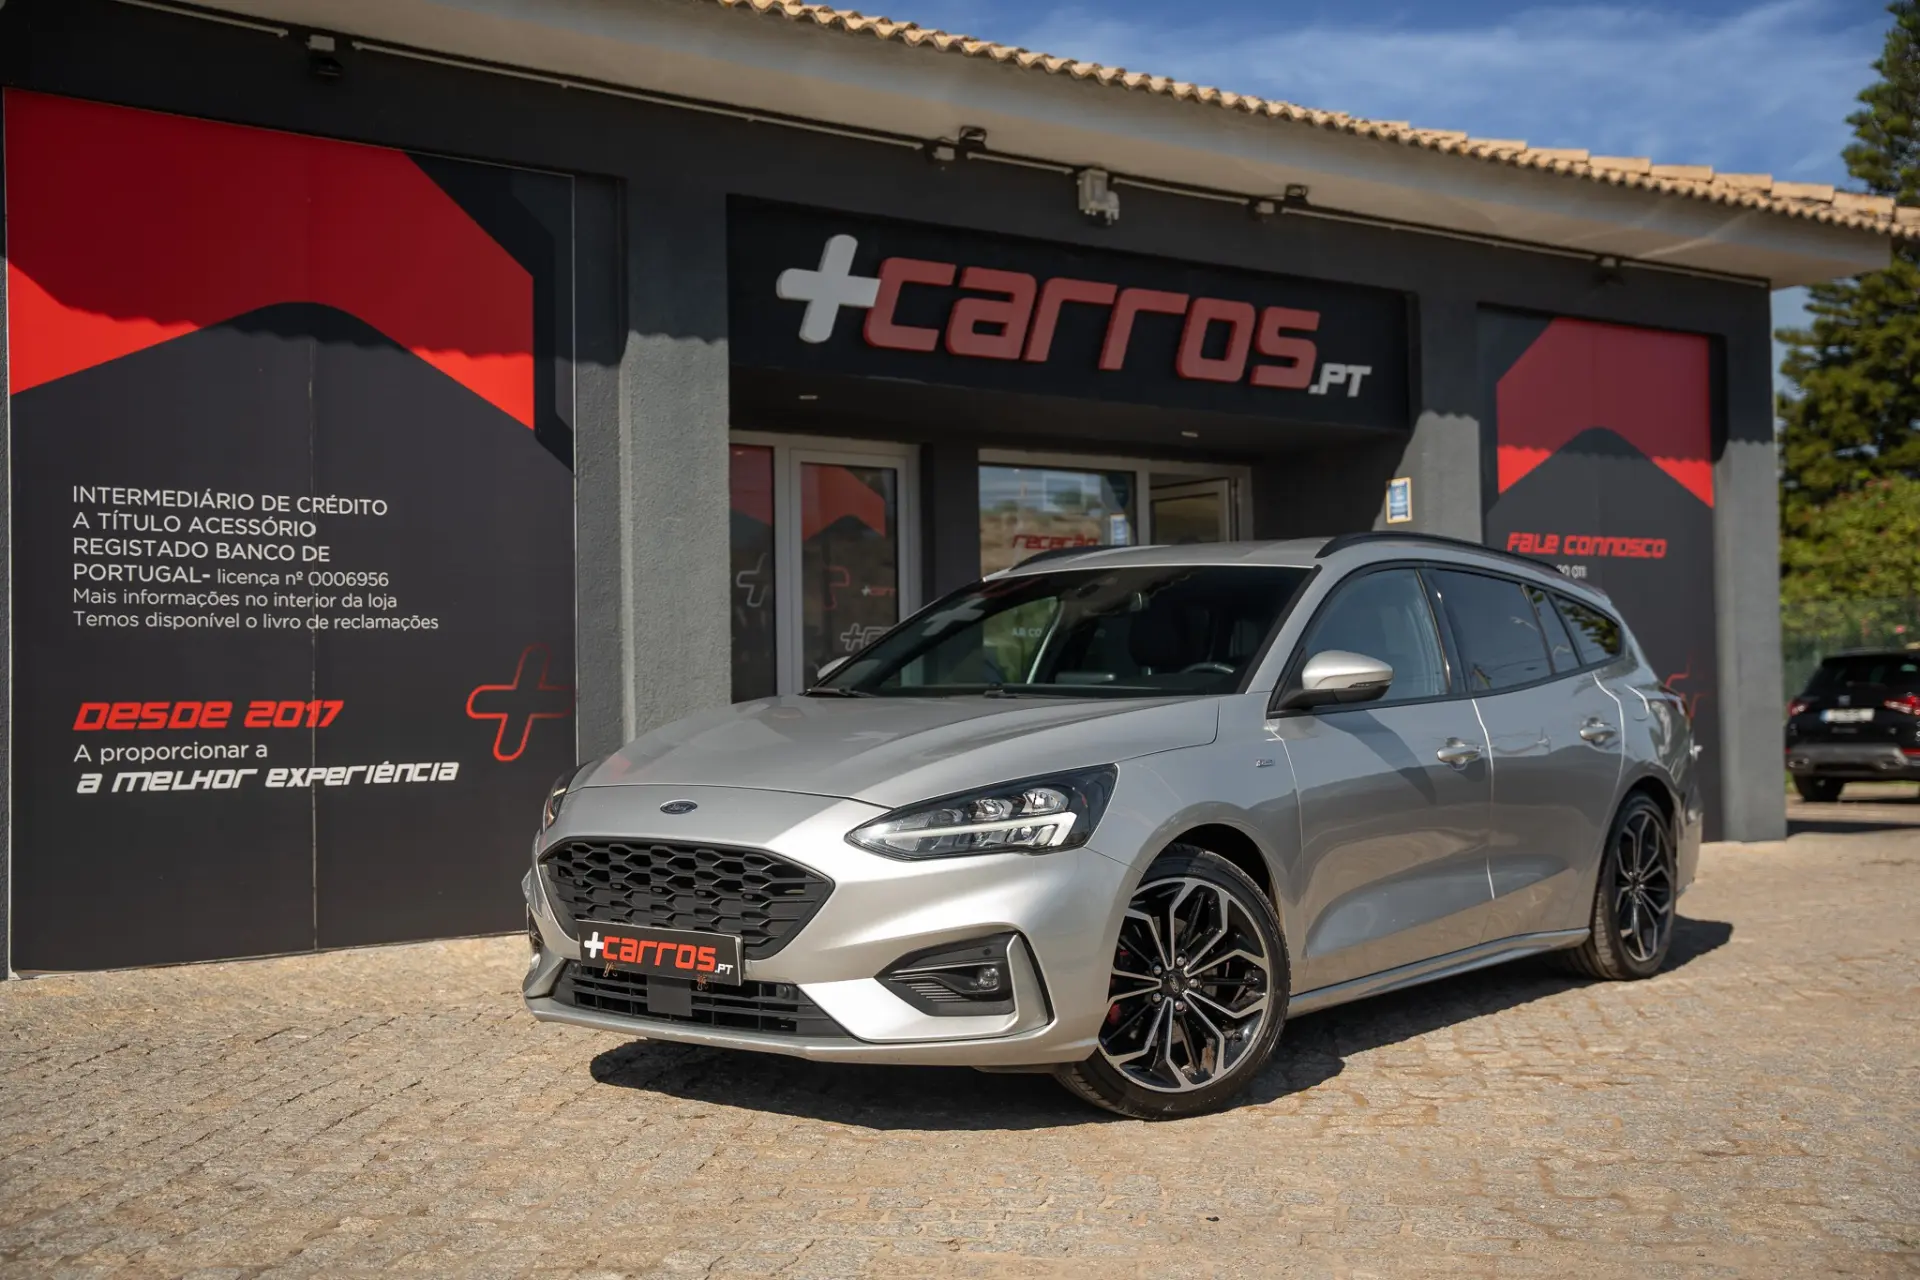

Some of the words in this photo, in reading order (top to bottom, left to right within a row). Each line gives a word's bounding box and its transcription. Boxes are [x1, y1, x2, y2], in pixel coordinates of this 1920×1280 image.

[73, 485, 255, 511] INTERMEDIÁRIO
[261, 494, 291, 512] DE
[296, 494, 388, 516] CRÉDITO
[72, 511, 90, 529] A
[97, 509, 181, 532] TÍTULO
[188, 516, 317, 538] ACESSÓRIO
[73, 537, 209, 559] REGISTADO
[216, 542, 296, 561] BANCO
[302, 545, 331, 562] DE
[73, 563, 211, 583] PORTUGAL-
[216, 568, 280, 587] licença
[285, 570, 304, 586] nº
[308, 571, 390, 587] 0006956
[73, 588, 117, 604] Mais
[123, 588, 240, 608] informações
[245, 594, 268, 607] no
[273, 592, 337, 608] interior
[341, 593, 363, 608] da
[368, 593, 398, 611] loja
[73, 610, 139, 628] Temos
[145, 612, 240, 630] disponível
[245, 616, 258, 628] o
[262, 613, 301, 629] livro
[306, 614, 329, 629] de
[334, 614, 439, 632] reclamações
[243, 699, 345, 728] 2017
[73, 744, 92, 763] A
[100, 741, 250, 766] proporcionar
[255, 744, 268, 758] a
[76, 772, 103, 794] a
